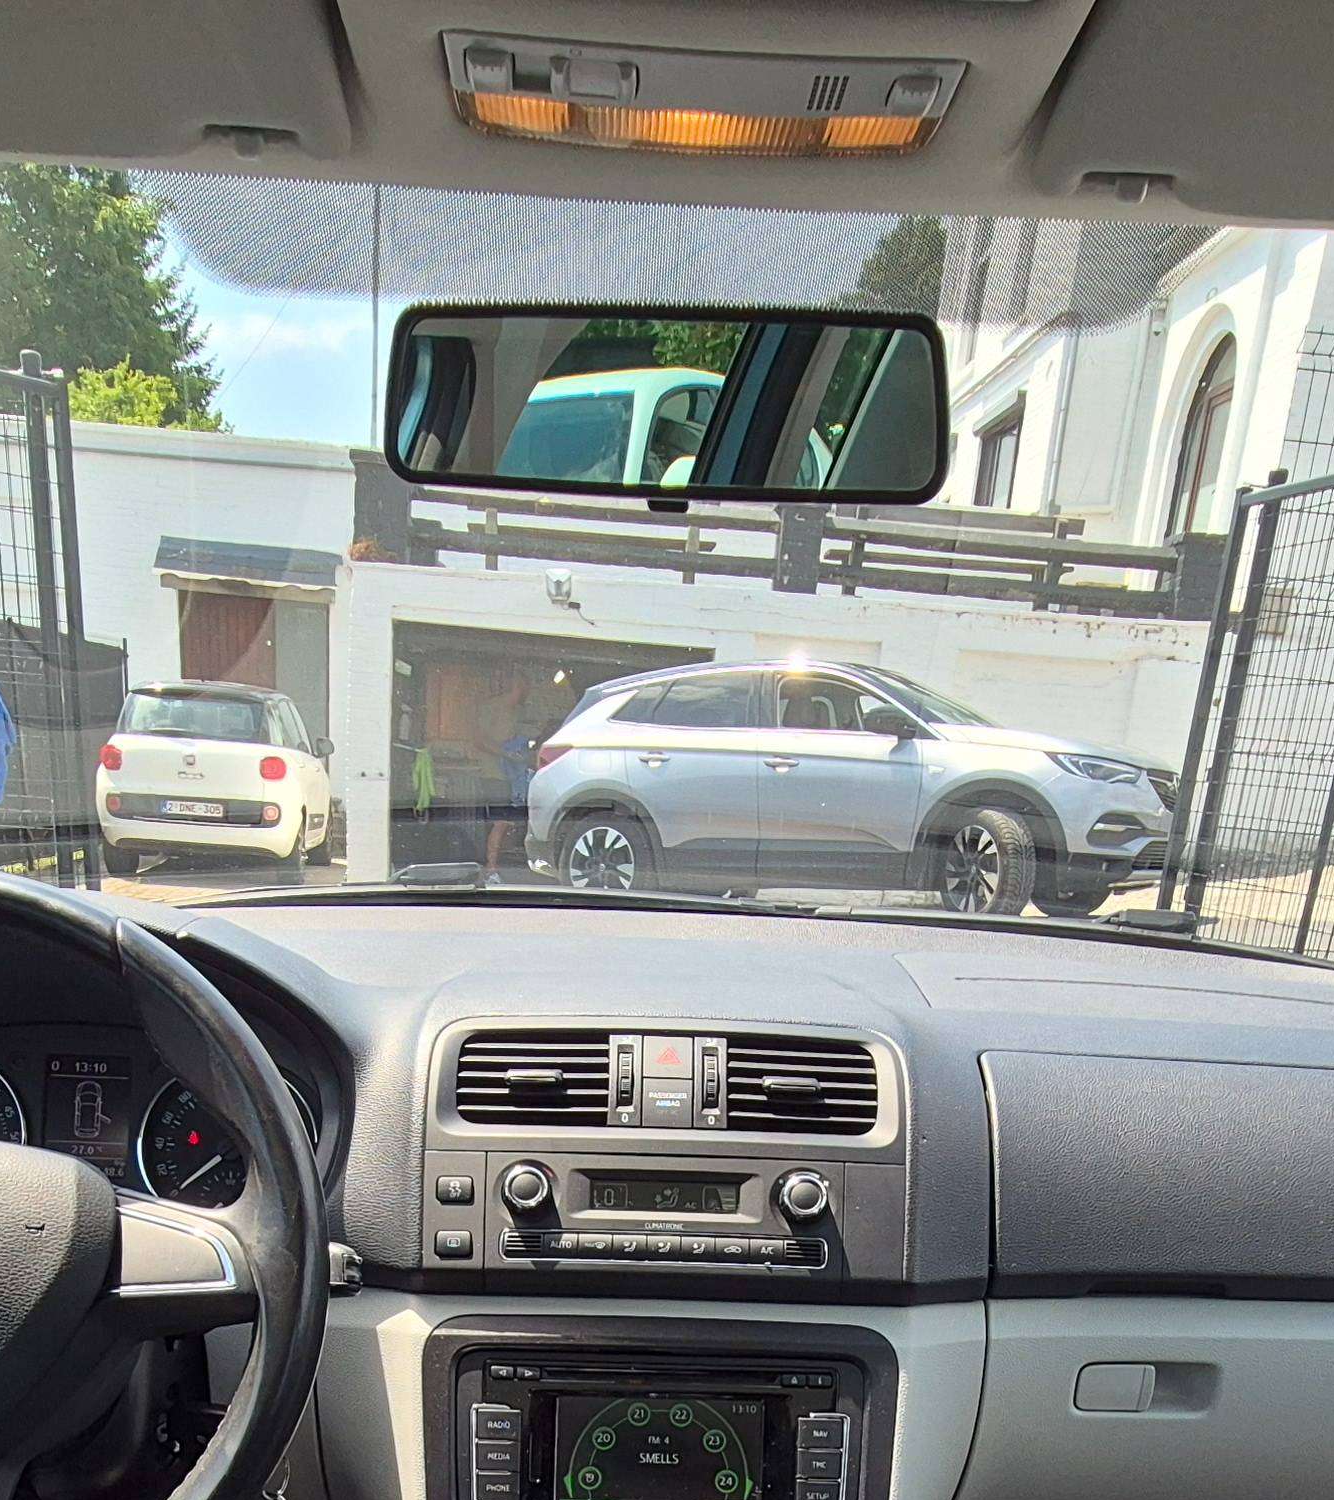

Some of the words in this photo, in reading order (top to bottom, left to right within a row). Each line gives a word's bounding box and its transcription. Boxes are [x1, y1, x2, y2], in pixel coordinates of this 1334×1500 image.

[75, 1062, 107, 1073] 13:10
[178, 1090, 192, 1103] 80
[4, 1106, 15, 1118] 45
[155, 1137, 165, 1149] 40
[550, 1240, 572, 1248] AUTO
[761, 1246, 774, 1254] A/C
[634, 1409, 644, 1418] 21
[675, 1410, 687, 1420] 22
[487, 1421, 511, 1429] RADIO
[597, 1433, 610, 1443] 20
[664, 1436, 670, 1444] 4
[708, 1435, 720, 1445] 23
[639, 1453, 680, 1464] SMELLS
[585, 1474, 595, 1482] 19
[720, 1476, 732, 1486] 24
[486, 1484, 511, 1492] PHONE
[806, 1492, 830, 1500] SETUP
